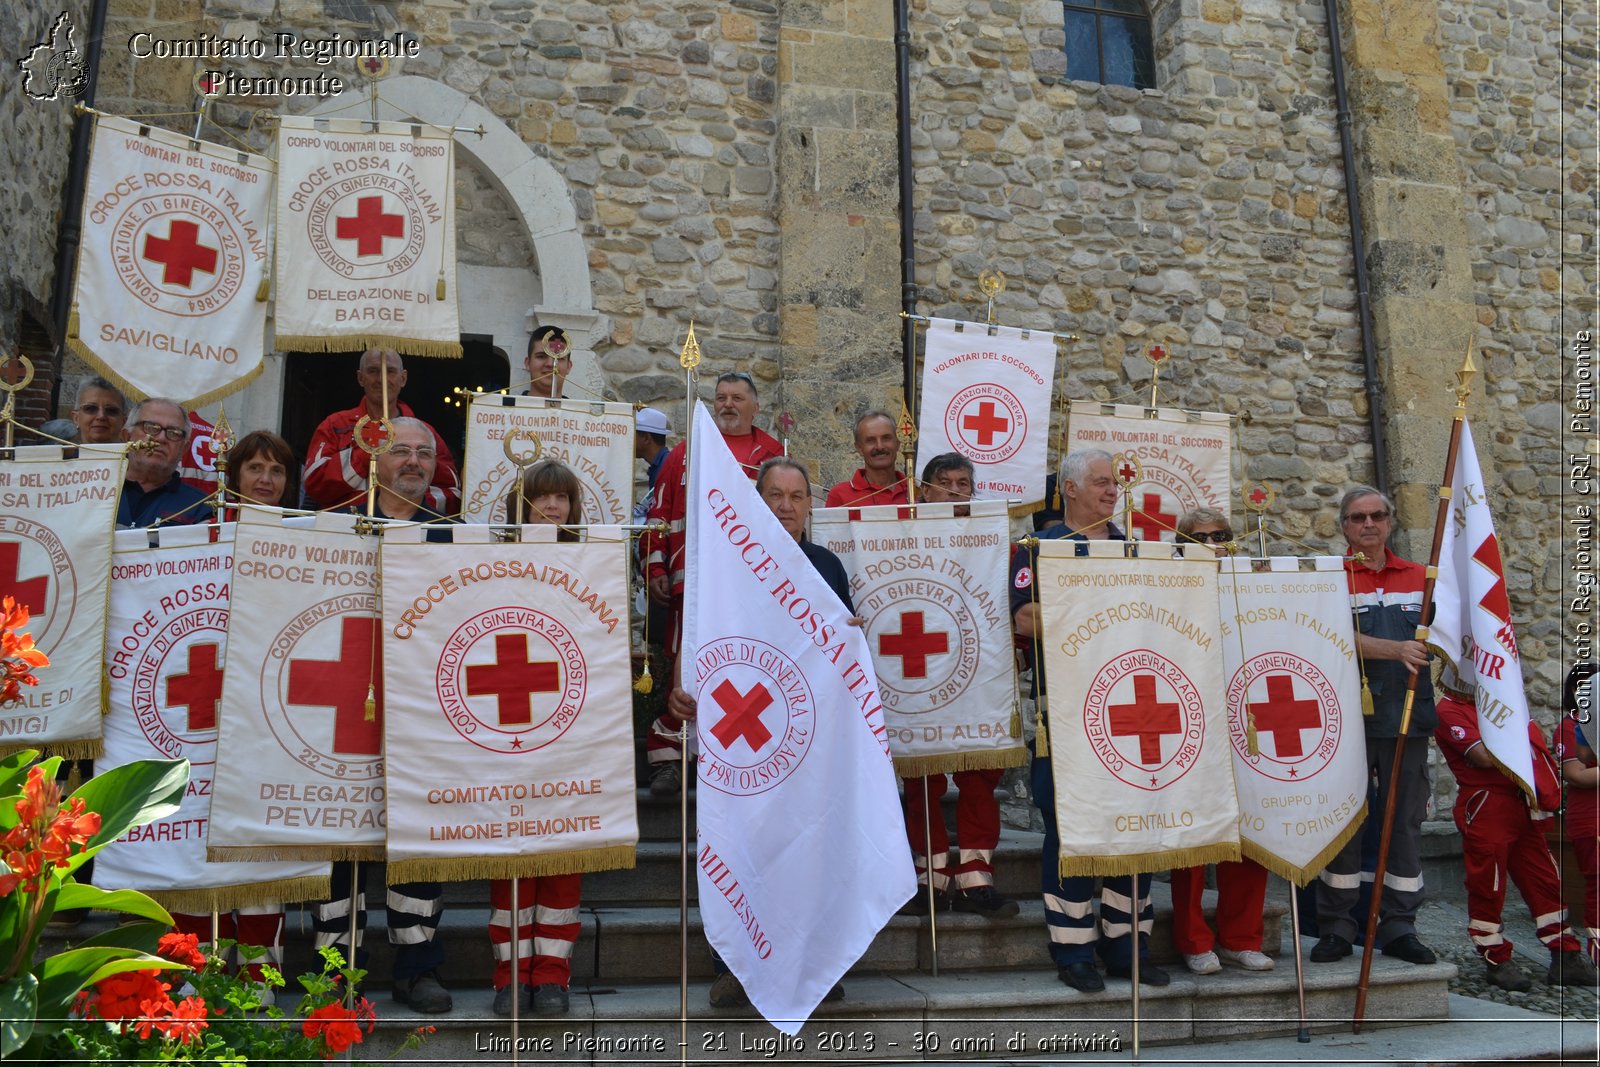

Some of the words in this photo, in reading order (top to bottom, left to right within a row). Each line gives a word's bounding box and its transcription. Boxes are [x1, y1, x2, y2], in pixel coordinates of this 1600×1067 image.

[287, 136, 320, 148] CORPO
[324, 140, 376, 153] VOLONTARI
[379, 141, 396, 152] DEL
[125, 139, 181, 164] VOLONTARI
[187, 157, 205, 169] DEL
[210, 162, 258, 183] SOCCORSO
[288, 166, 331, 213] CROCE
[333, 156, 390, 175] ROSSA
[396, 162, 442, 224] ITALIANA
[326, 188, 341, 201] DI
[341, 176, 396, 193] GINEVRA
[399, 188, 413, 203] 22
[90, 175, 142, 225] CROCE
[144, 172, 212, 194] ROSSA
[216, 188, 269, 262] ITALIANA
[142, 201, 158, 214] DI
[163, 198, 225, 230] GINEVRA
[222, 235, 237, 250] 22
[311, 199, 354, 275] CONVENZIONE
[410, 208, 423, 255] AGOSTO
[116, 211, 159, 303] CONVENZIONE
[387, 254, 413, 273] 1864
[220, 254, 240, 299] AGOSTO
[188, 294, 221, 312] 1864
[307, 288, 412, 301] DELEGAZIONE
[417, 293, 429, 304] DI
[335, 307, 405, 321] BARGE
[100, 324, 238, 364] SAVIGLIANO
[933, 352, 980, 374] VOLONTARI
[982, 352, 999, 360] DEL
[1001, 354, 1044, 385] SOCCORSO
[949, 387, 992, 420] CONVENZIONE
[995, 388, 1003, 397] DI
[1003, 394, 1023, 426] GINEVRA
[510, 414, 560, 427] VOLONTARI
[564, 419, 580, 431] DEL
[585, 422, 628, 435] SOCCORSO
[563, 434, 568, 444] E
[572, 435, 610, 447] PIONIERI
[1077, 429, 1106, 442] CORPO
[1112, 431, 1159, 443] VOLONTARI
[1162, 435, 1178, 446] DEL
[1181, 437, 1223, 449] SOCCORSO
[956, 441, 964, 450] 22
[964, 448, 996, 460] AGOSTO
[998, 445, 1014, 458] 1864
[20, 474, 44, 487] DEL
[50, 468, 110, 487] SOCCORSO
[977, 481, 986, 490] di
[989, 482, 1026, 494] MONTA'
[37, 486, 116, 508] ITALIANA
[468, 461, 509, 515] CROCE
[575, 455, 626, 525] ITALIANA
[584, 497, 597, 514] 22
[1182, 494, 1195, 509] 22
[15, 521, 32, 534] DI
[35, 529, 69, 574] GINEVRA
[252, 540, 296, 559] CORPO
[861, 537, 918, 551] VOLONTARI
[924, 536, 944, 549] DEL
[950, 533, 999, 548] SOCCORSO
[112, 563, 152, 580] CORPO
[156, 557, 220, 576] VOLONTARI
[237, 560, 316, 584] CROCE
[707, 488, 780, 582] CROCE
[770, 577, 847, 665] ROSSA
[1058, 575, 1090, 587] CORPO
[1092, 574, 1142, 587] VOLONTARI
[1144, 575, 1158, 587] DEL
[1159, 575, 1205, 588] SOCCORSO
[1256, 584, 1277, 594] DEL
[1282, 583, 1337, 594] SOCCORSO
[393, 575, 459, 641] CROCE
[458, 560, 537, 586] ROSSA
[540, 565, 620, 634] ITALIANA
[865, 554, 935, 581] ROSSA
[940, 558, 1001, 631] ITALIANA
[870, 594, 884, 610] DI
[889, 583, 954, 606] GINEVRA
[481, 612, 545, 631] GINEVRA
[956, 607, 970, 625] 22
[110, 610, 159, 679] CROCE
[160, 583, 229, 615] ROSSA
[271, 597, 375, 659] CONVENZIONE
[466, 623, 481, 639] DI
[546, 624, 564, 642] 22
[1060, 611, 1109, 658] CROCE
[1109, 602, 1154, 625] ROSSA
[1155, 607, 1213, 652] ITALIANA
[1235, 608, 1287, 625] ROSSA
[1295, 612, 1354, 662] ITALIANA
[154, 635, 170, 653] DI
[740, 644, 756, 663] DI
[960, 629, 975, 679] AGOSTO
[561, 639, 583, 701] AGOSTO
[1106, 664, 1121, 679] DI
[1120, 655, 1166, 674] GINEVRA
[1242, 666, 1255, 679] DI
[1254, 656, 1303, 672] GINEVRA
[1304, 668, 1320, 682] 22
[441, 633, 477, 735] CONVENZIONE
[759, 651, 808, 718] GINEVRA
[1166, 668, 1183, 685] 22
[59, 688, 73, 704] DI
[929, 678, 962, 706] 1864
[137, 656, 182, 757] CONVENZIONE
[552, 703, 577, 731] 1864
[1179, 682, 1200, 740] AGOSTO
[1317, 681, 1338, 734] AGOSTO
[923, 727, 943, 742] DI
[952, 722, 1007, 740] ALBA
[1087, 674, 1124, 772] CONVENZIONE
[788, 726, 807, 746] 22
[1176, 743, 1197, 768] 1864
[1319, 736, 1336, 762] 1864
[706, 760, 735, 788] 1864
[740, 744, 797, 789] AGOSTO
[427, 783, 527, 805] COMITATO
[531, 779, 602, 798] LOCALE
[1261, 796, 1312, 809] GRUPPO
[1318, 793, 1329, 804] DI
[510, 804, 524, 817] DI
[1115, 811, 1193, 832] CENTALLO
[1282, 792, 1358, 836] TORINESE
[429, 823, 502, 841] LIMONE
[506, 816, 601, 838] PIEMONTE
[697, 843, 772, 960] MILLESIMO
